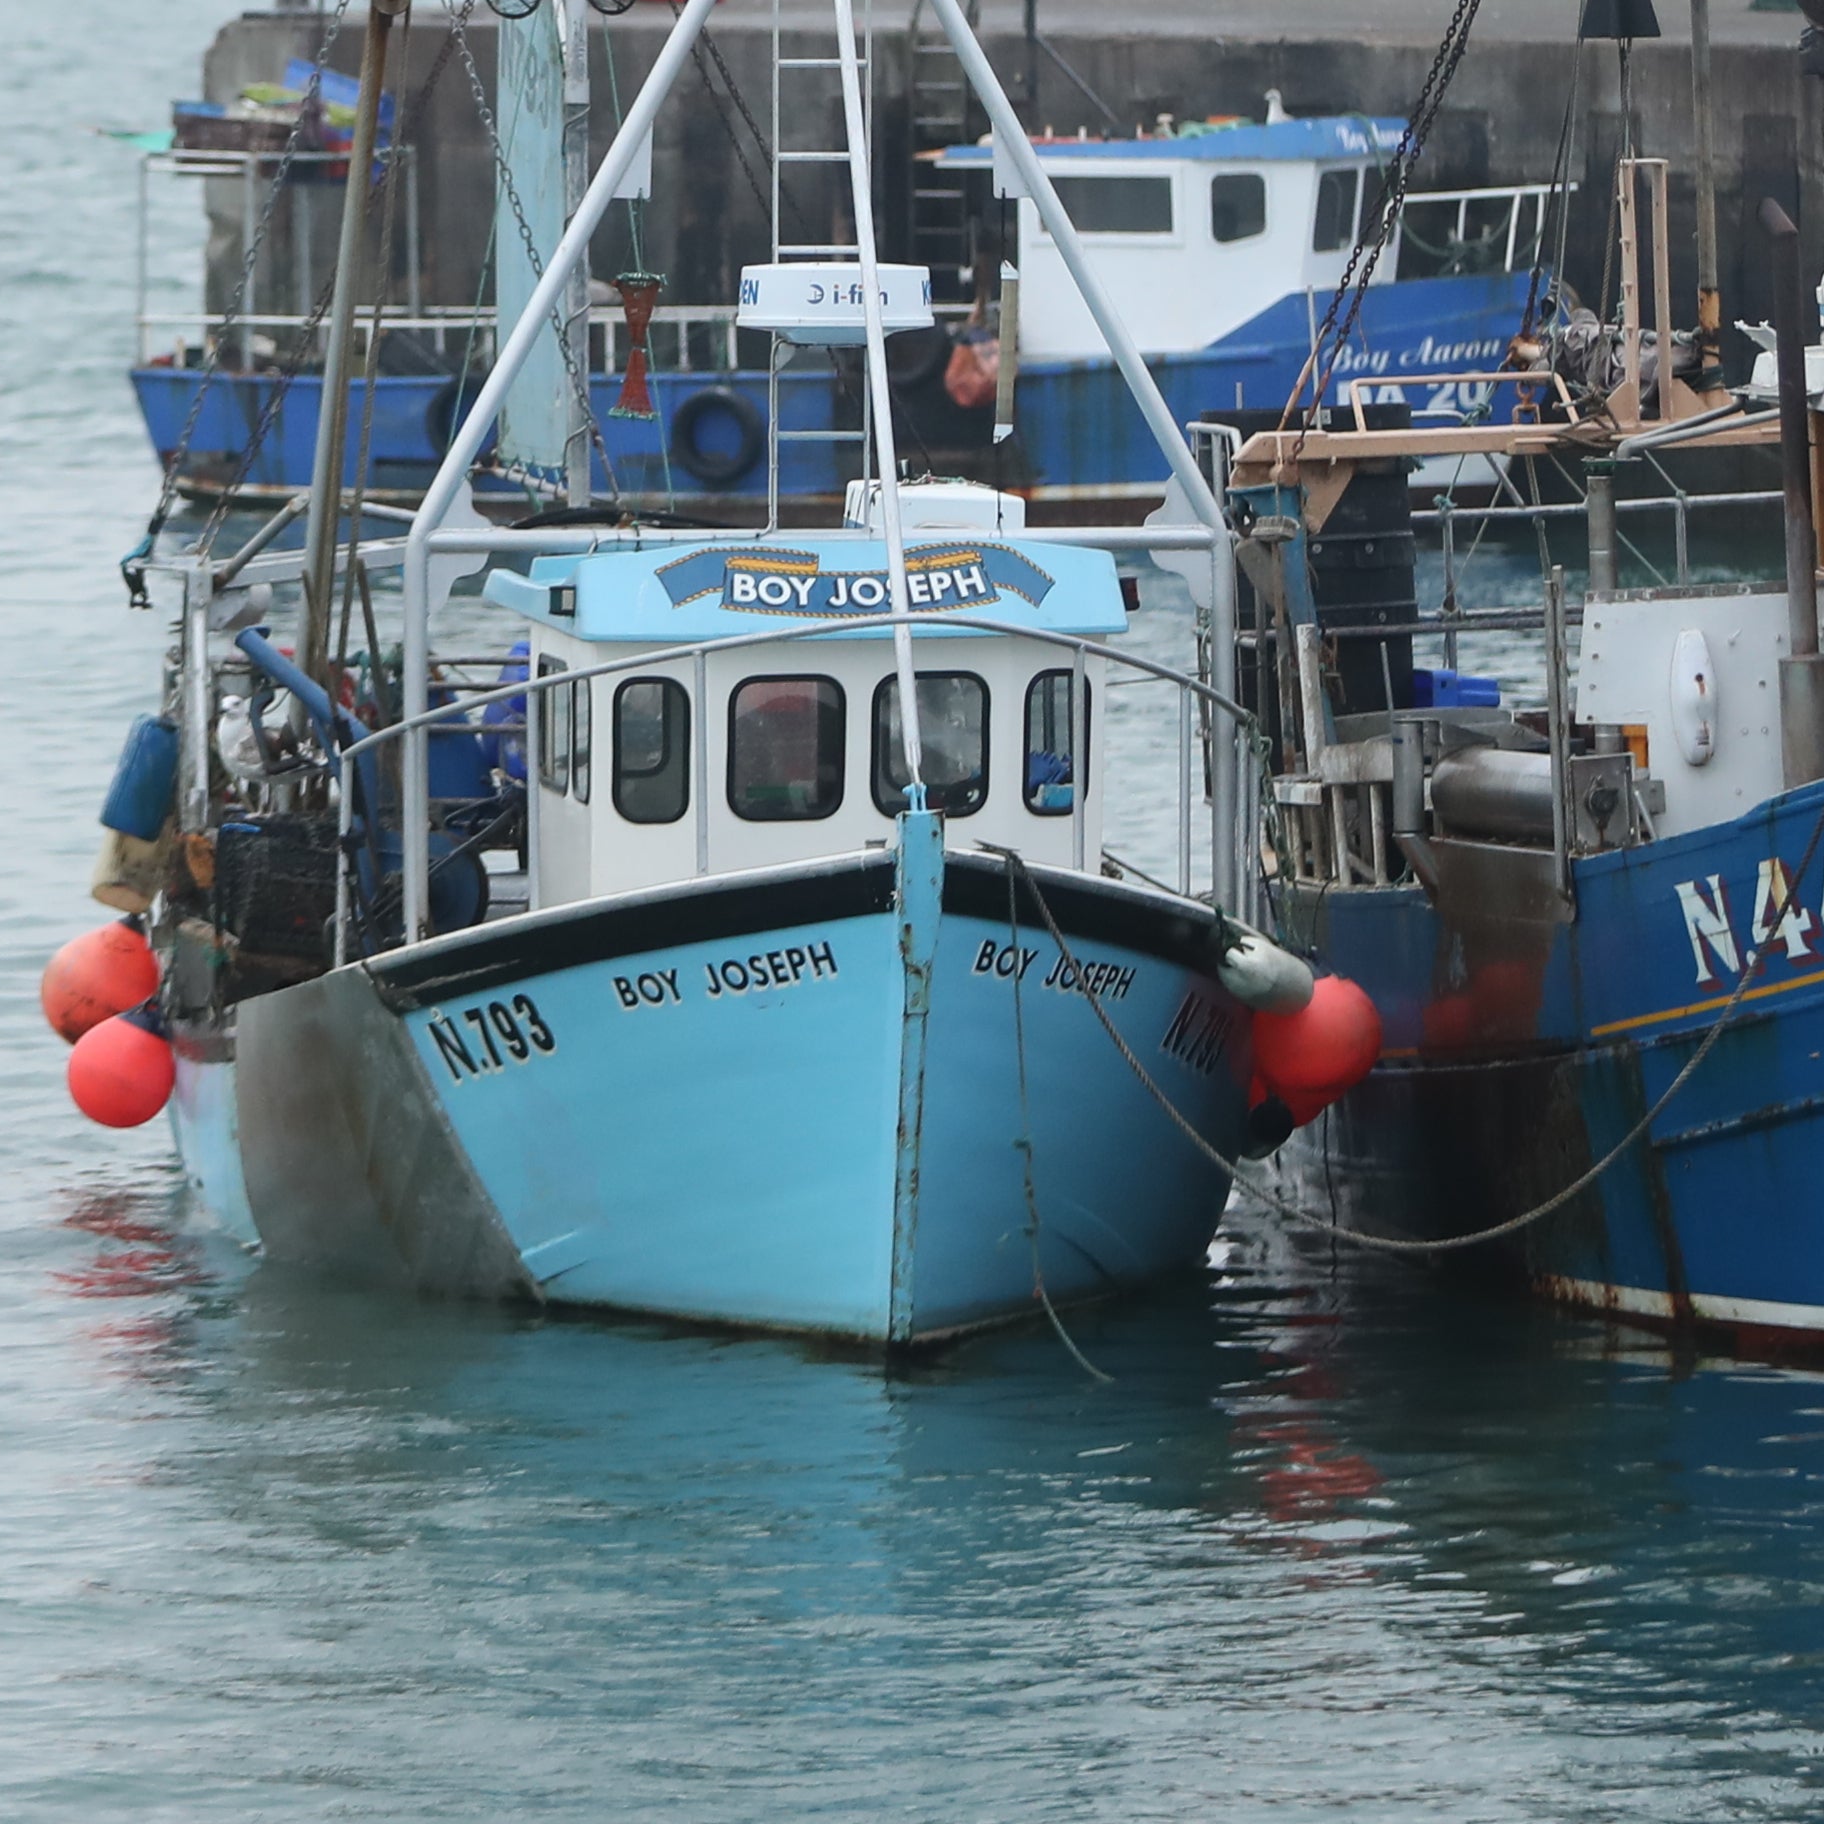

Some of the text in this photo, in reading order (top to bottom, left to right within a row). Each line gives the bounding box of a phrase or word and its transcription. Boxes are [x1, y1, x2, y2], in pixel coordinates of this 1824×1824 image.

[833, 283, 888, 306] i-fi
[1323, 335, 1501, 373] Boy Aaron
[733, 565, 987, 607] BOY JOEPH
[612, 941, 838, 1011] BOY JOSEPH
[972, 939, 1136, 1001] BOY JOSEPH
[428, 993, 557, 1085] N.793
